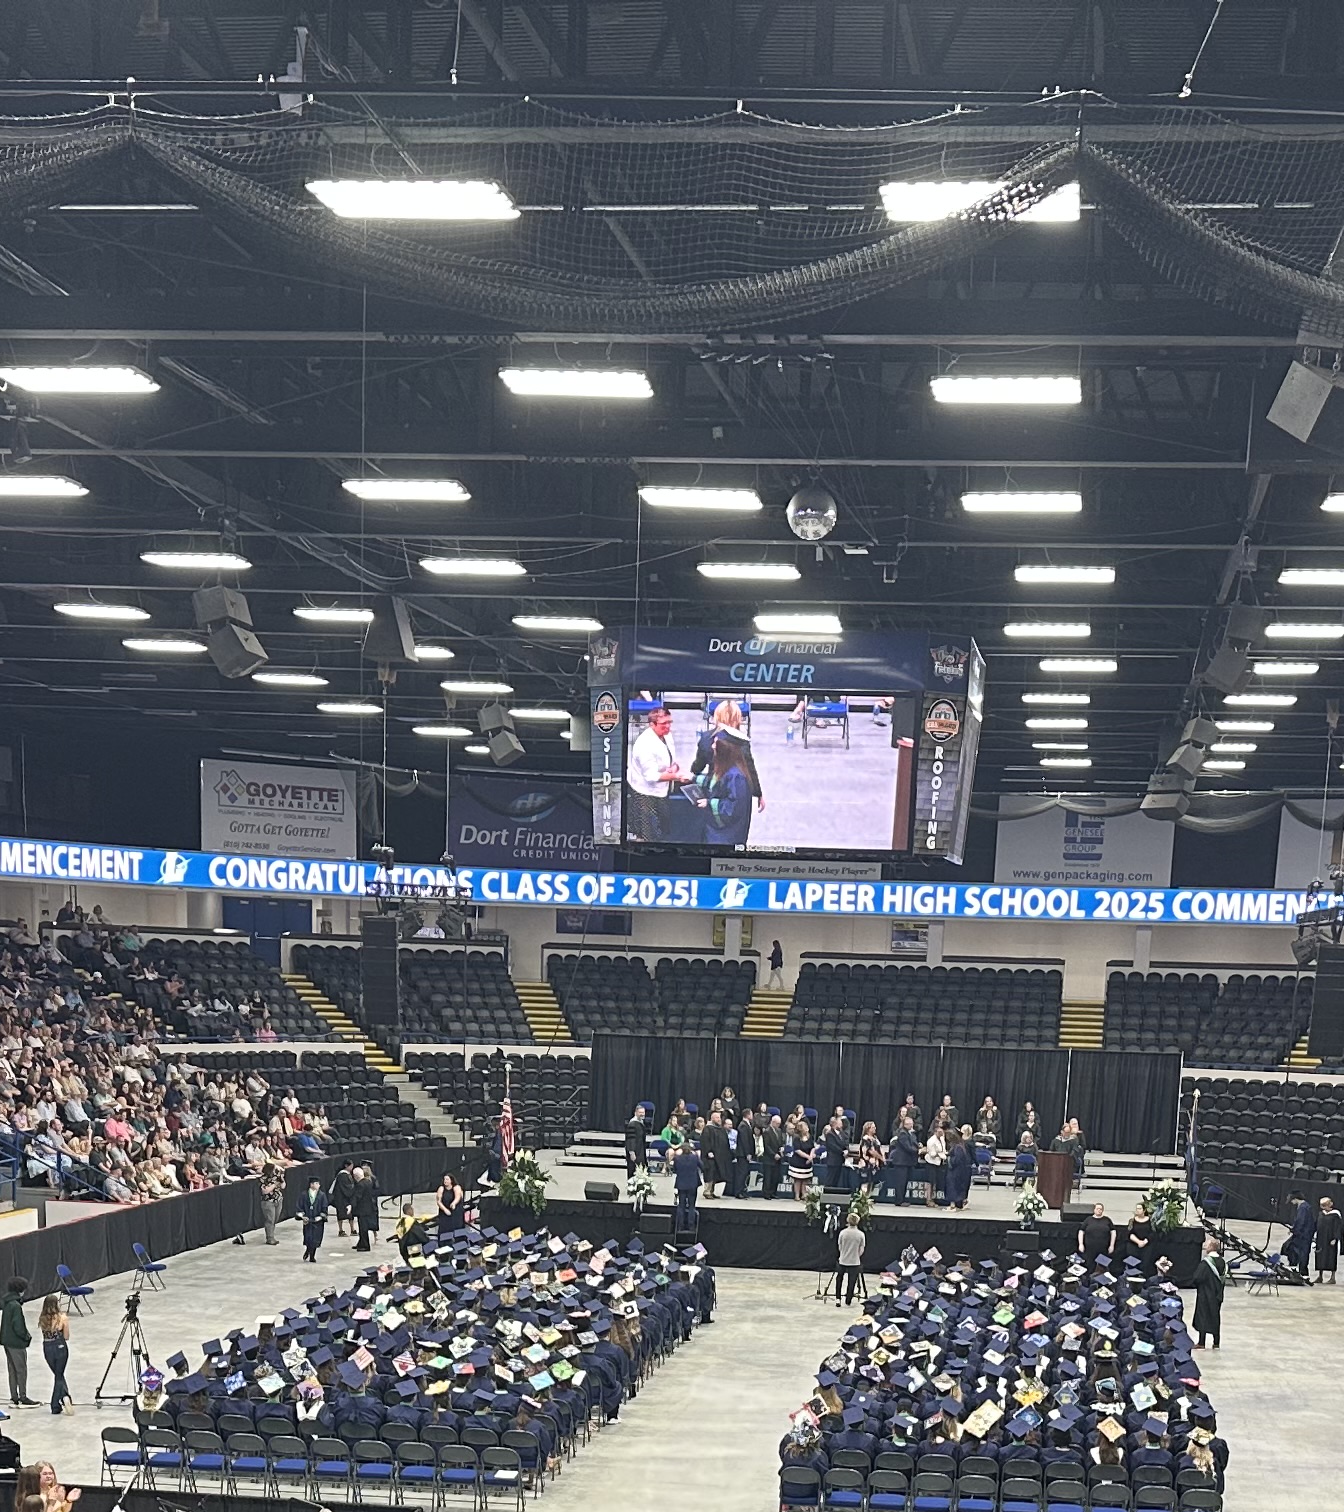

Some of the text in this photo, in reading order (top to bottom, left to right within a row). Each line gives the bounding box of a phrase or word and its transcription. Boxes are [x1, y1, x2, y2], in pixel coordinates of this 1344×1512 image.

[708, 637, 741, 654] Dort
[777, 640, 838, 656] Financial
[729, 662, 815, 684] CENTER
[245, 781, 340, 803] GOYETTE
[602, 737, 612, 837] SIDING
[926, 745, 944, 850] ROOFING
[248, 798, 338, 812] MECHANICAL
[459, 825, 599, 850] Dort Financia
[1064, 828, 1105, 837] GENESEE
[512, 848, 600, 862] CREDIT UNION
[1064, 844, 1097, 853] GROUP
[1012, 869, 1153, 882] www.genpackaging.com
[481, 872, 570, 904] CLASS
[577, 876, 616, 905] OF
[623, 877, 698, 908] 2025!
[768, 882, 875, 913] LAPEER
[881, 885, 957, 915] HIGH
[963, 888, 1086, 919] SCHOOL
[1092, 890, 1165, 921] 2025
